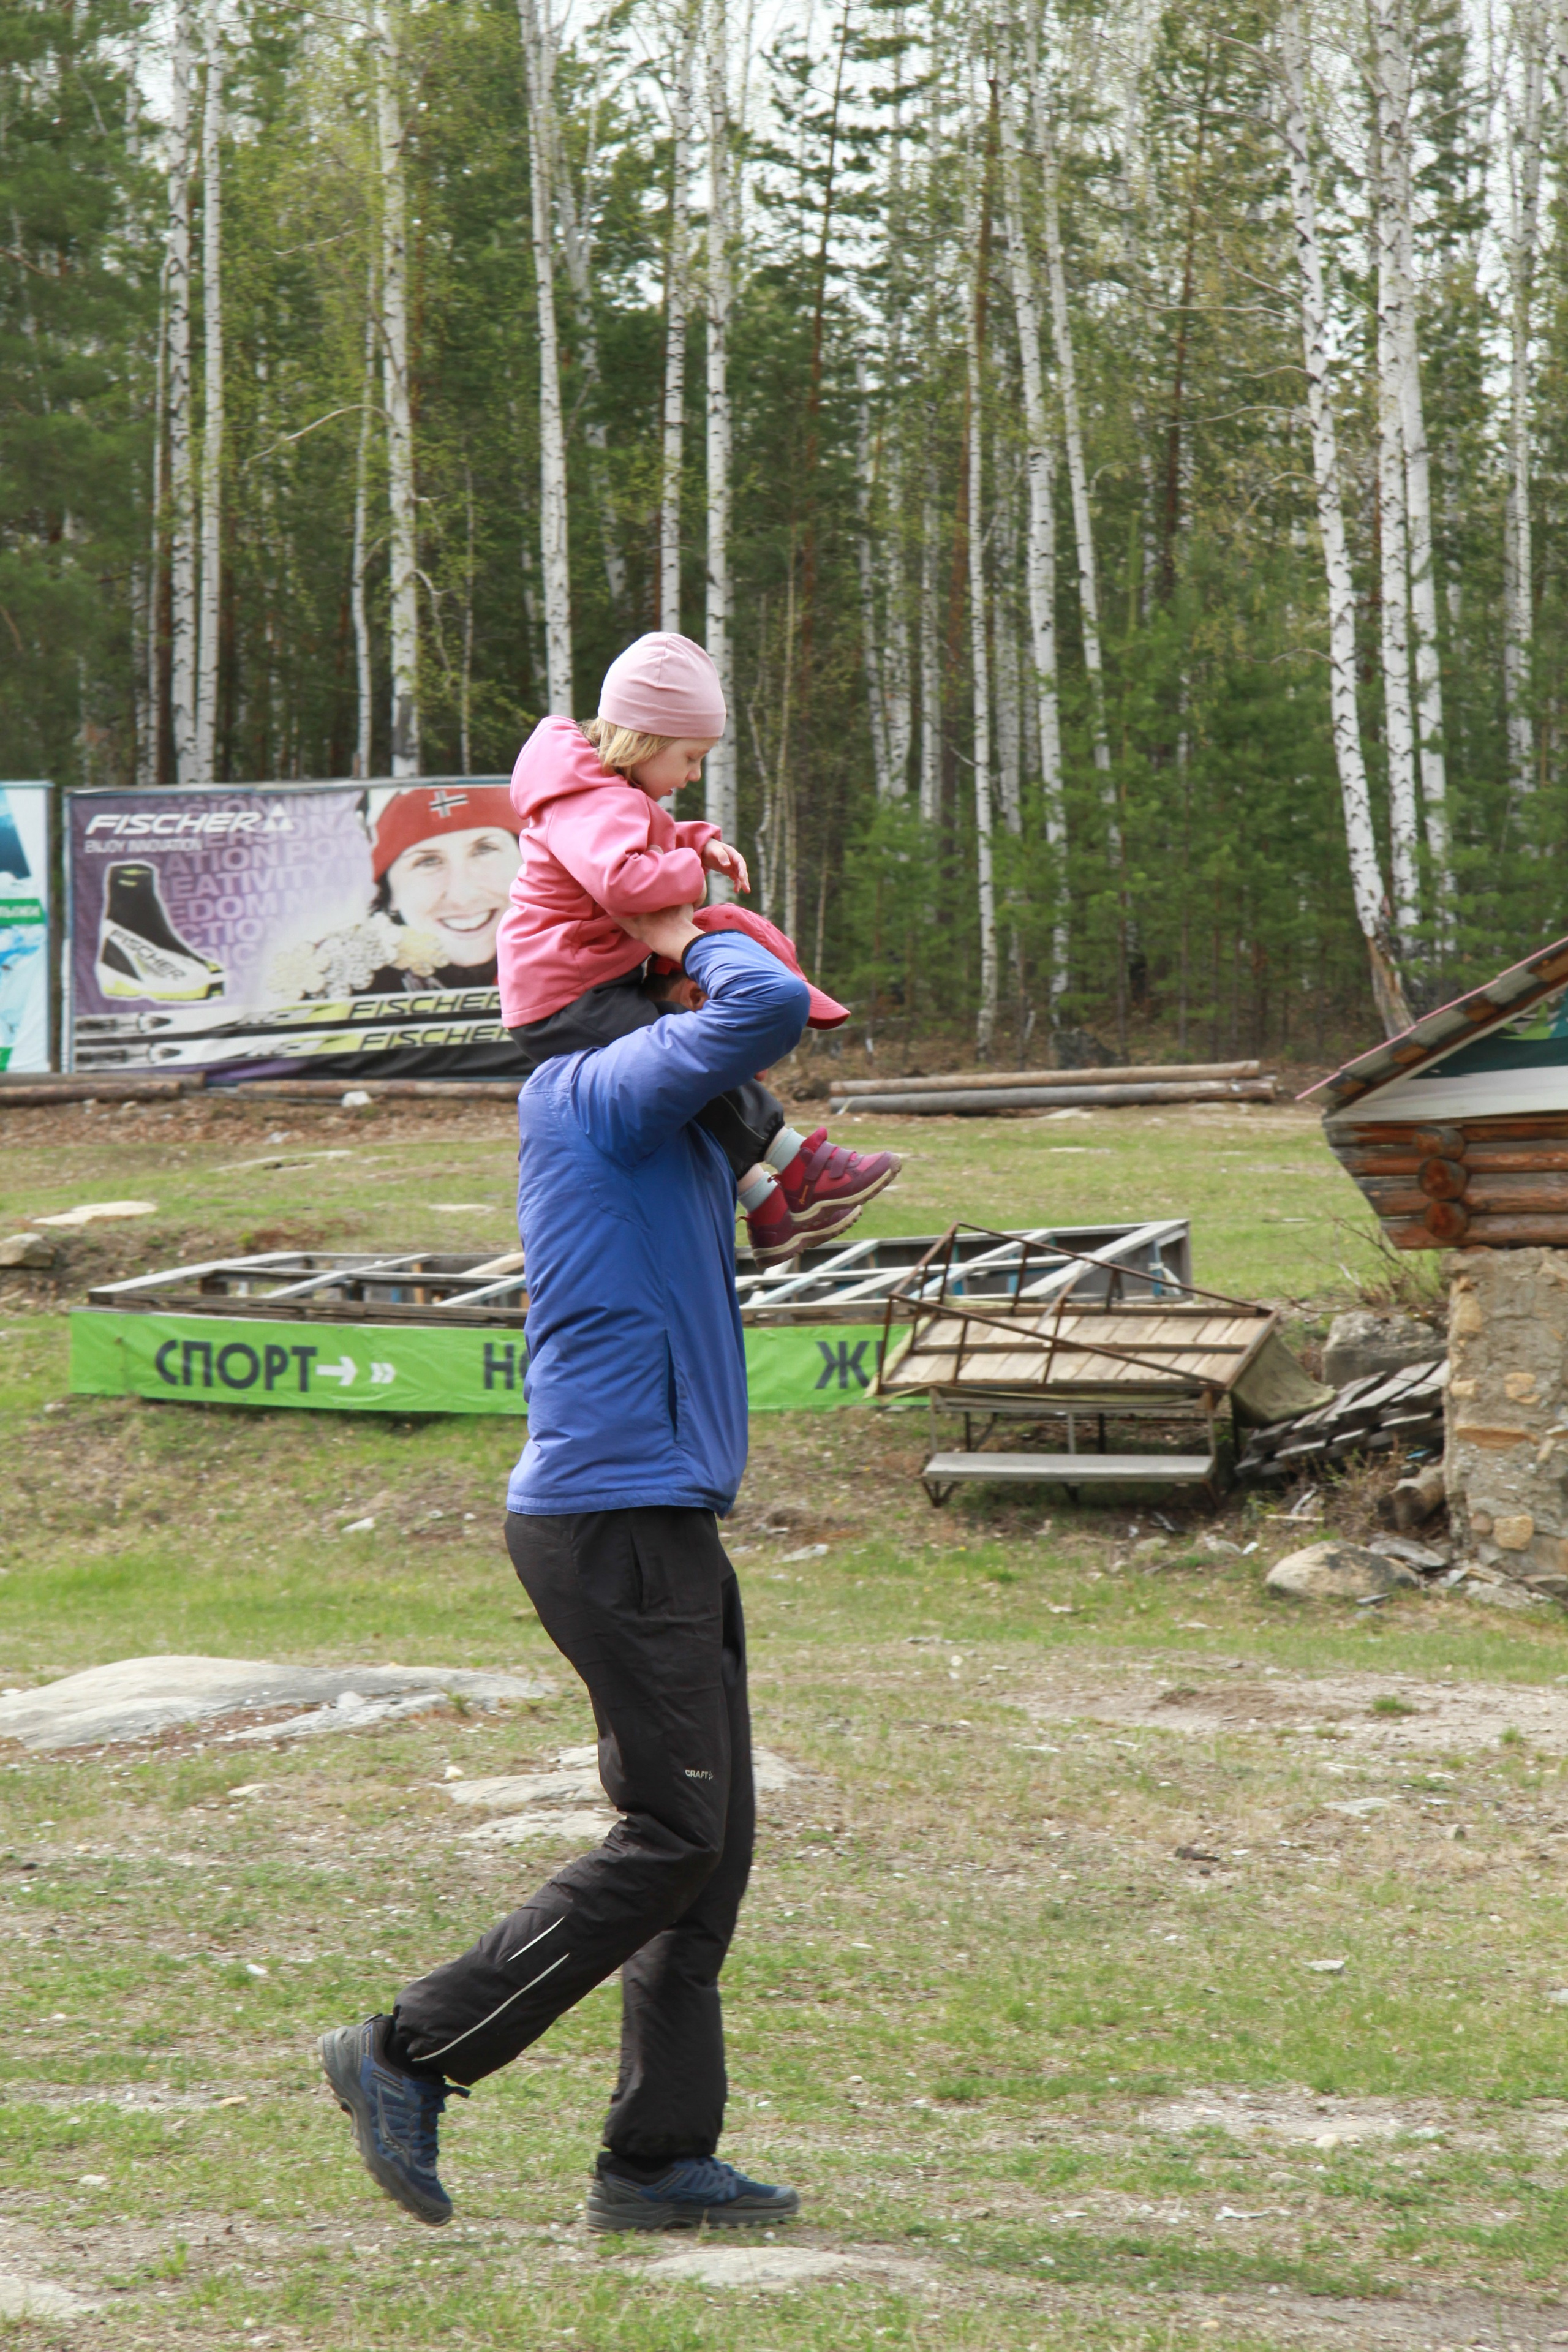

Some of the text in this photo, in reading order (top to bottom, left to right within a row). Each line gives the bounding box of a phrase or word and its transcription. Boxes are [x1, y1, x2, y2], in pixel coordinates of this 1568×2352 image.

[85, 812, 263, 835] FISCHER
[156, 1339, 318, 1393] СПОРТ
[483, 1342, 527, 1390] Н
[685, 1769, 709, 1779] CRAFT
